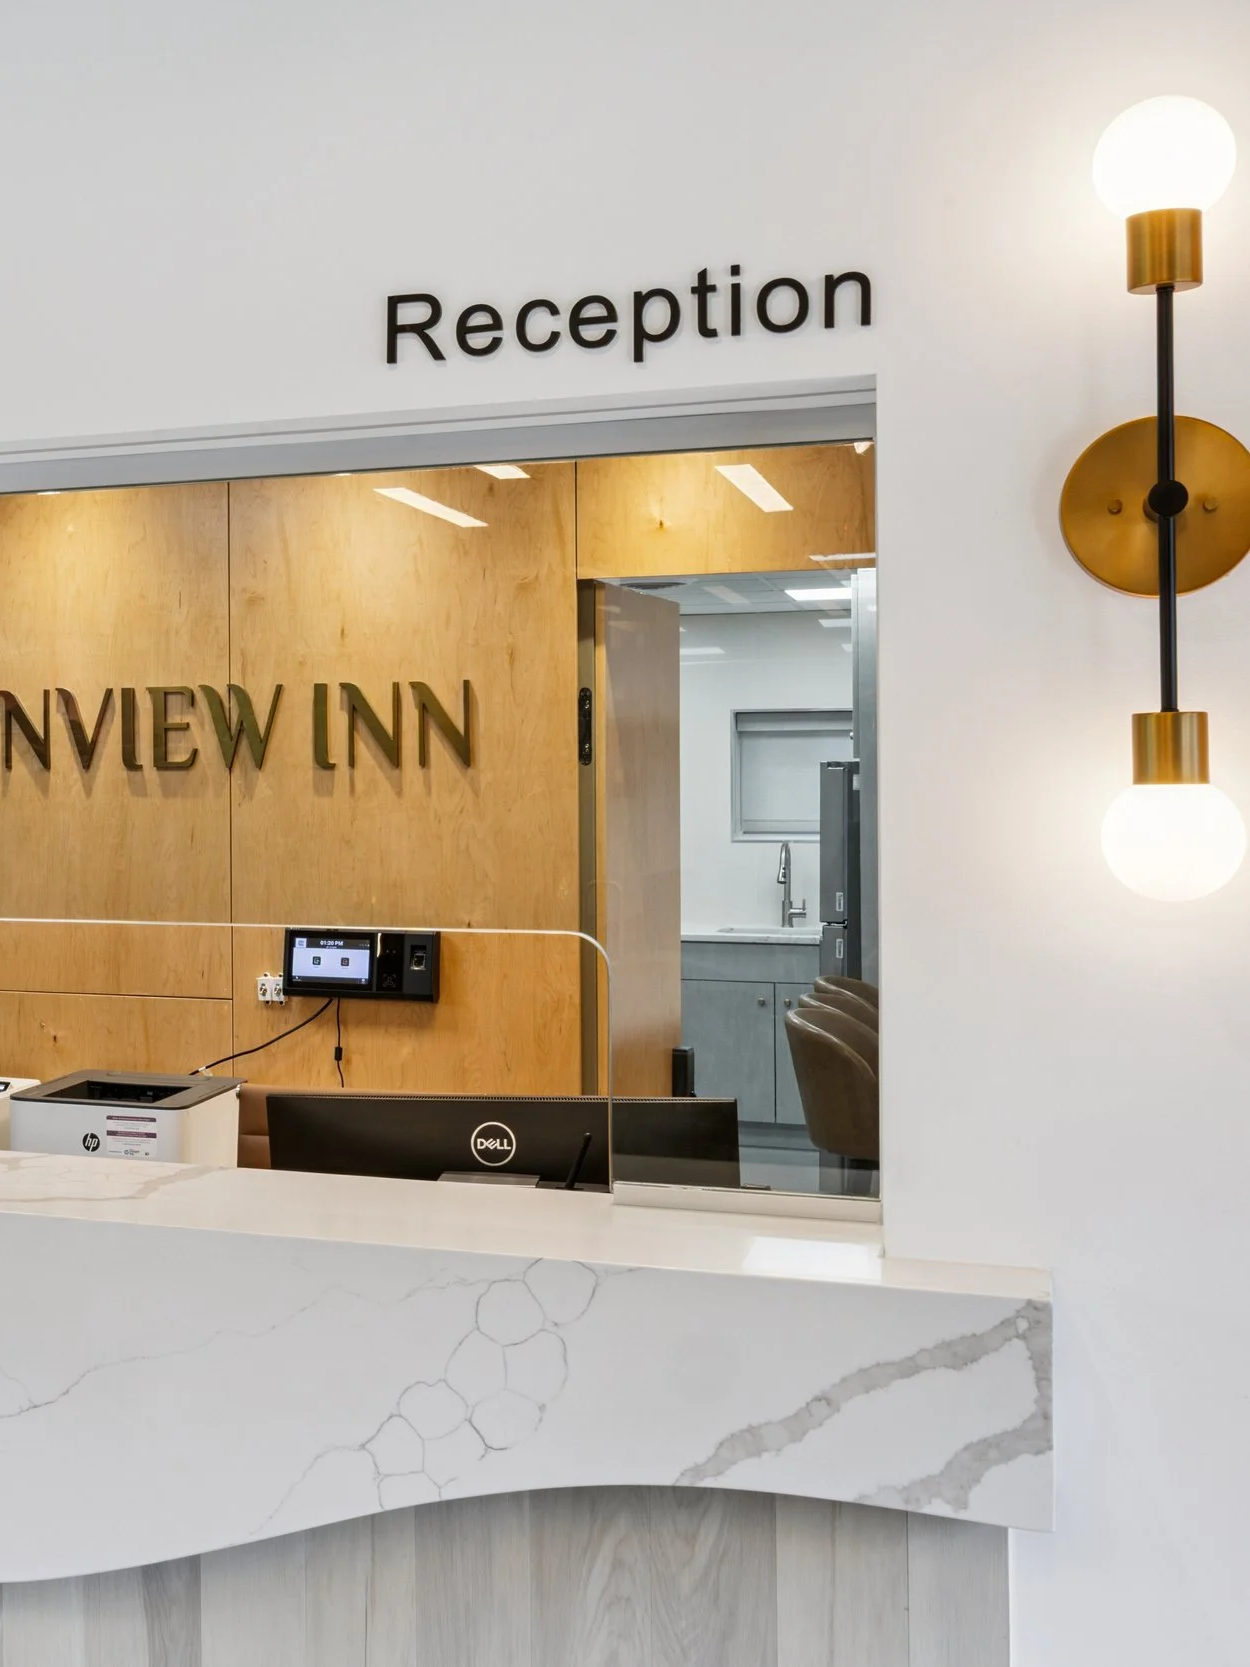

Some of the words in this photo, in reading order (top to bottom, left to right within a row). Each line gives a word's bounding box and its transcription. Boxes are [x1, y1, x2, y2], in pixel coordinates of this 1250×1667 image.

[385, 264, 872, 364] Reception
[311, 679, 471, 770] INN
[82, 1132, 100, 1152] hp
[476, 1138, 511, 1150] DELL
